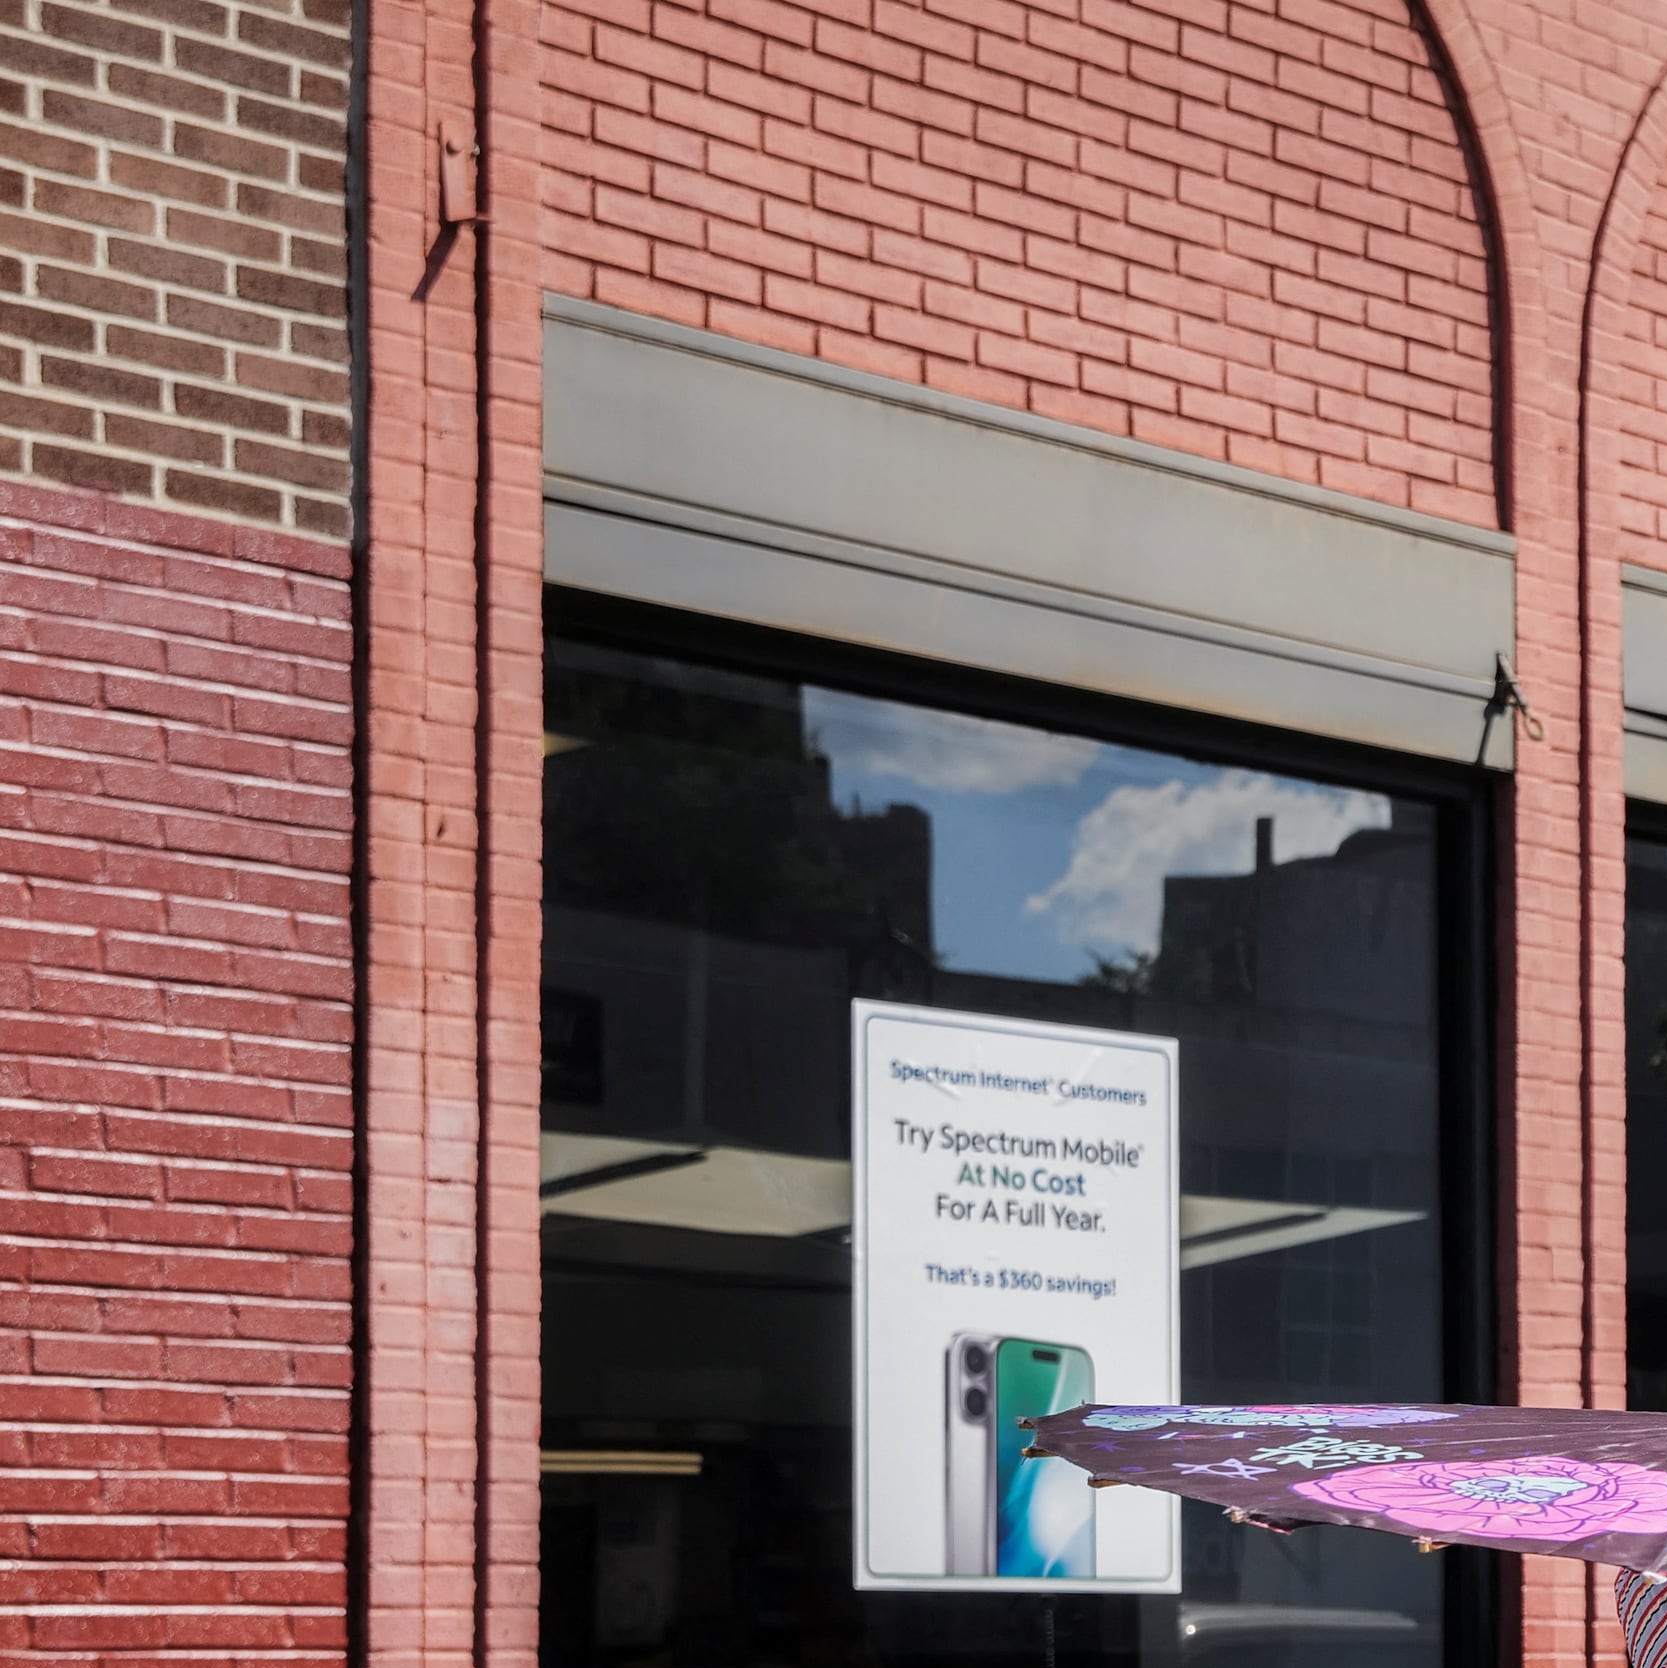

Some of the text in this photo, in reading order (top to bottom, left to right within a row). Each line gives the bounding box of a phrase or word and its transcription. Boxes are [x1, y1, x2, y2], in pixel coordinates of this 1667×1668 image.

[891, 1059, 976, 1085] Spectrum
[1059, 1081, 1148, 1107] Customers
[895, 1120, 934, 1153] Try
[940, 1124, 1056, 1160] Spectrum
[958, 1161, 1087, 1197] At No Cost
[936, 1194, 1106, 1232] For A Full Year.
[925, 1262, 1117, 1301] That's a $360 savings!
